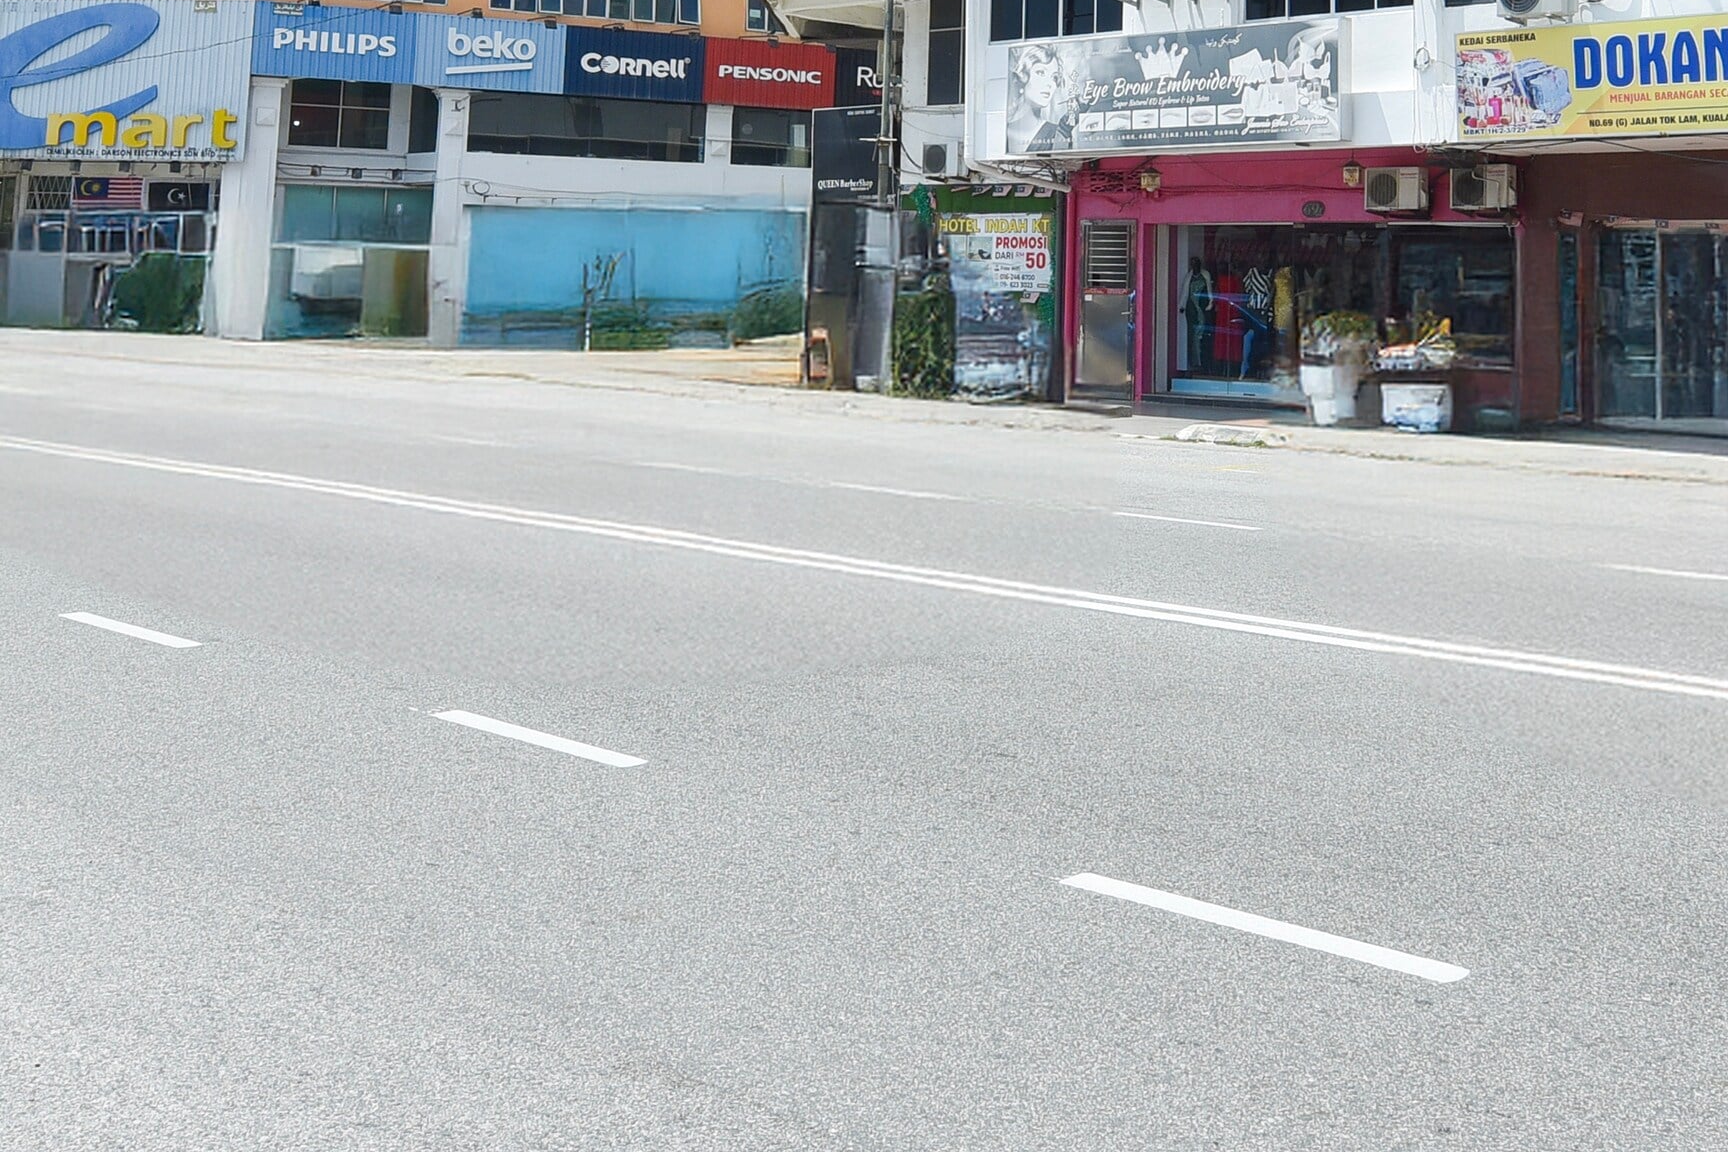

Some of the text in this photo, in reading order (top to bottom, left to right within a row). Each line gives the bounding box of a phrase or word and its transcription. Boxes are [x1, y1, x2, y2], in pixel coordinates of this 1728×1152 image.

[273, 28, 397, 57] PHILIPS
[447, 27, 537, 60] beko
[1459, 33, 1536, 46] KEDAI SERBANEKA
[718, 64, 822, 85] PENSONIC
[1083, 79, 1109, 105] Eye
[1113, 78, 1153, 98] Brow
[1157, 68, 1246, 97] Embroidery
[1609, 93, 1651, 104] MENJUAL
[1655, 90, 1706, 101] BARANGAN
[46, 108, 237, 149] mart
[1589, 119, 1613, 128] NO.69
[1616, 118, 1628, 127] (G)
[1630, 117, 1657, 126] JALAN
[1660, 116, 1676, 124] TOK
[1679, 115, 1700, 125] LAM,
[1463, 128, 1485, 136] MBKT
[818, 180, 840, 190] QUEEN
[939, 218, 1050, 234] HOTEL INDAH KT
[995, 236, 1047, 249] PROMOSI
[995, 251, 1014, 260] DARI
[1026, 252, 1047, 269] 50
